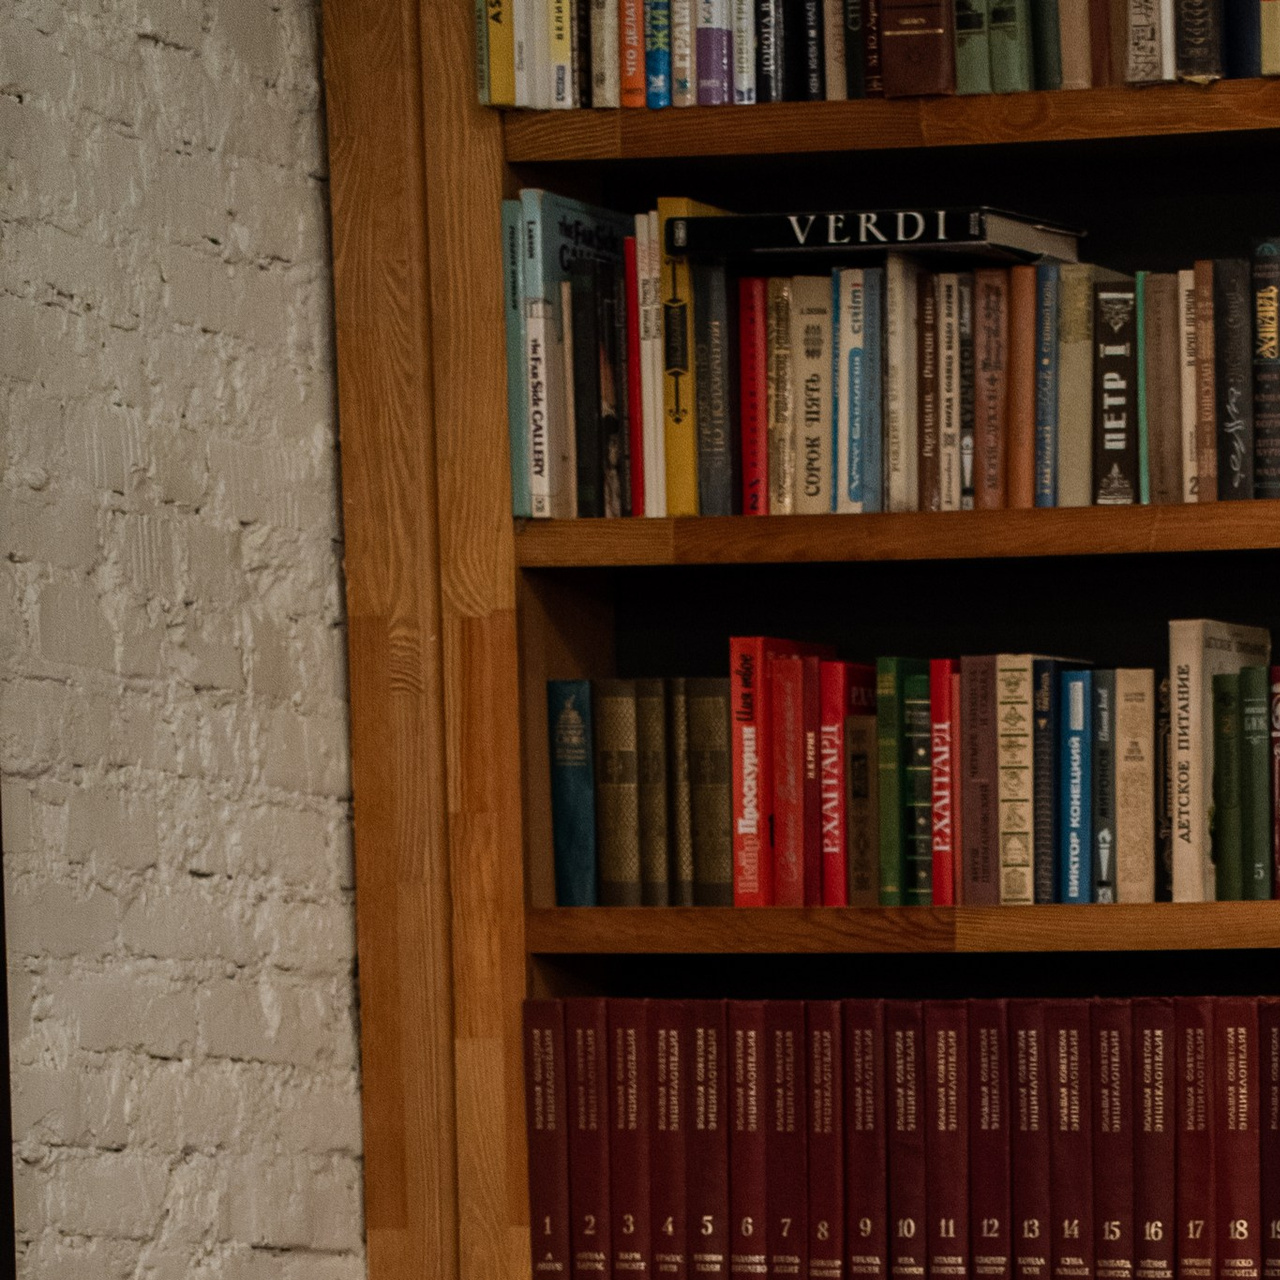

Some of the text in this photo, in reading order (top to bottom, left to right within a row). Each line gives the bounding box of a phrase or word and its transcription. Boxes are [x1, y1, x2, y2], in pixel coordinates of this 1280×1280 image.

[760, 17, 774, 75] ДОРОГА
[626, 51, 637, 76] ЧТО
[787, 210, 950, 245] VERDI
[1184, 288, 1197, 328] ПЕРВОМ
[532, 357, 543, 379] Far
[960, 337, 976, 431] КУРЧАТОВ
[532, 382, 544, 408] Side
[1099, 341, 1131, 451] ПЕТР I
[529, 411, 546, 478] GALLERY
[803, 372, 822, 497] СОРОК ПЯТЬ
[1187, 476, 1200, 496] 2
[1177, 663, 1192, 844] ДЕТСКОЕ ПИТАНИЕ
[736, 726, 760, 834] Проскурин
[1098, 748, 1110, 819] МИРОНОВ
[1066, 735, 1082, 898] ВИКТОР КОНЕЦКИЙ
[696, 1026, 705, 1130] БОЛЬШАЯ СОВЕТСКАЯ
[708, 1028, 717, 1131] ЭНЦИКЛОПЕДИЯ
[1227, 1026, 1236, 1131] БОЛЬШАЯ СОВЕТСКАЯ
[1238, 1026, 1248, 1132] ЭНЦИКЛОПЕДИЯ
[545, 1217, 552, 1235] 1
[585, 1215, 596, 1235] 2
[623, 1215, 635, 1234] 3
[663, 1216, 675, 1236] 4
[702, 1216, 714, 1235] 5
[743, 1217, 754, 1236] 6
[781, 1218, 792, 1238] 7
[817, 1221, 829, 1241] 8
[858, 1217, 873, 1238] 9
[899, 1219, 916, 1238] 10
[940, 1219, 956, 1238] 11
[983, 1219, 1000, 1238] 12
[1024, 1219, 1040, 1239] 13
[1064, 1220, 1079, 1239] 14
[1105, 1221, 1121, 1241] 15
[1146, 1221, 1163, 1241] 16
[1188, 1221, 1205, 1239] 17
[1231, 1220, 1249, 1240] 18
